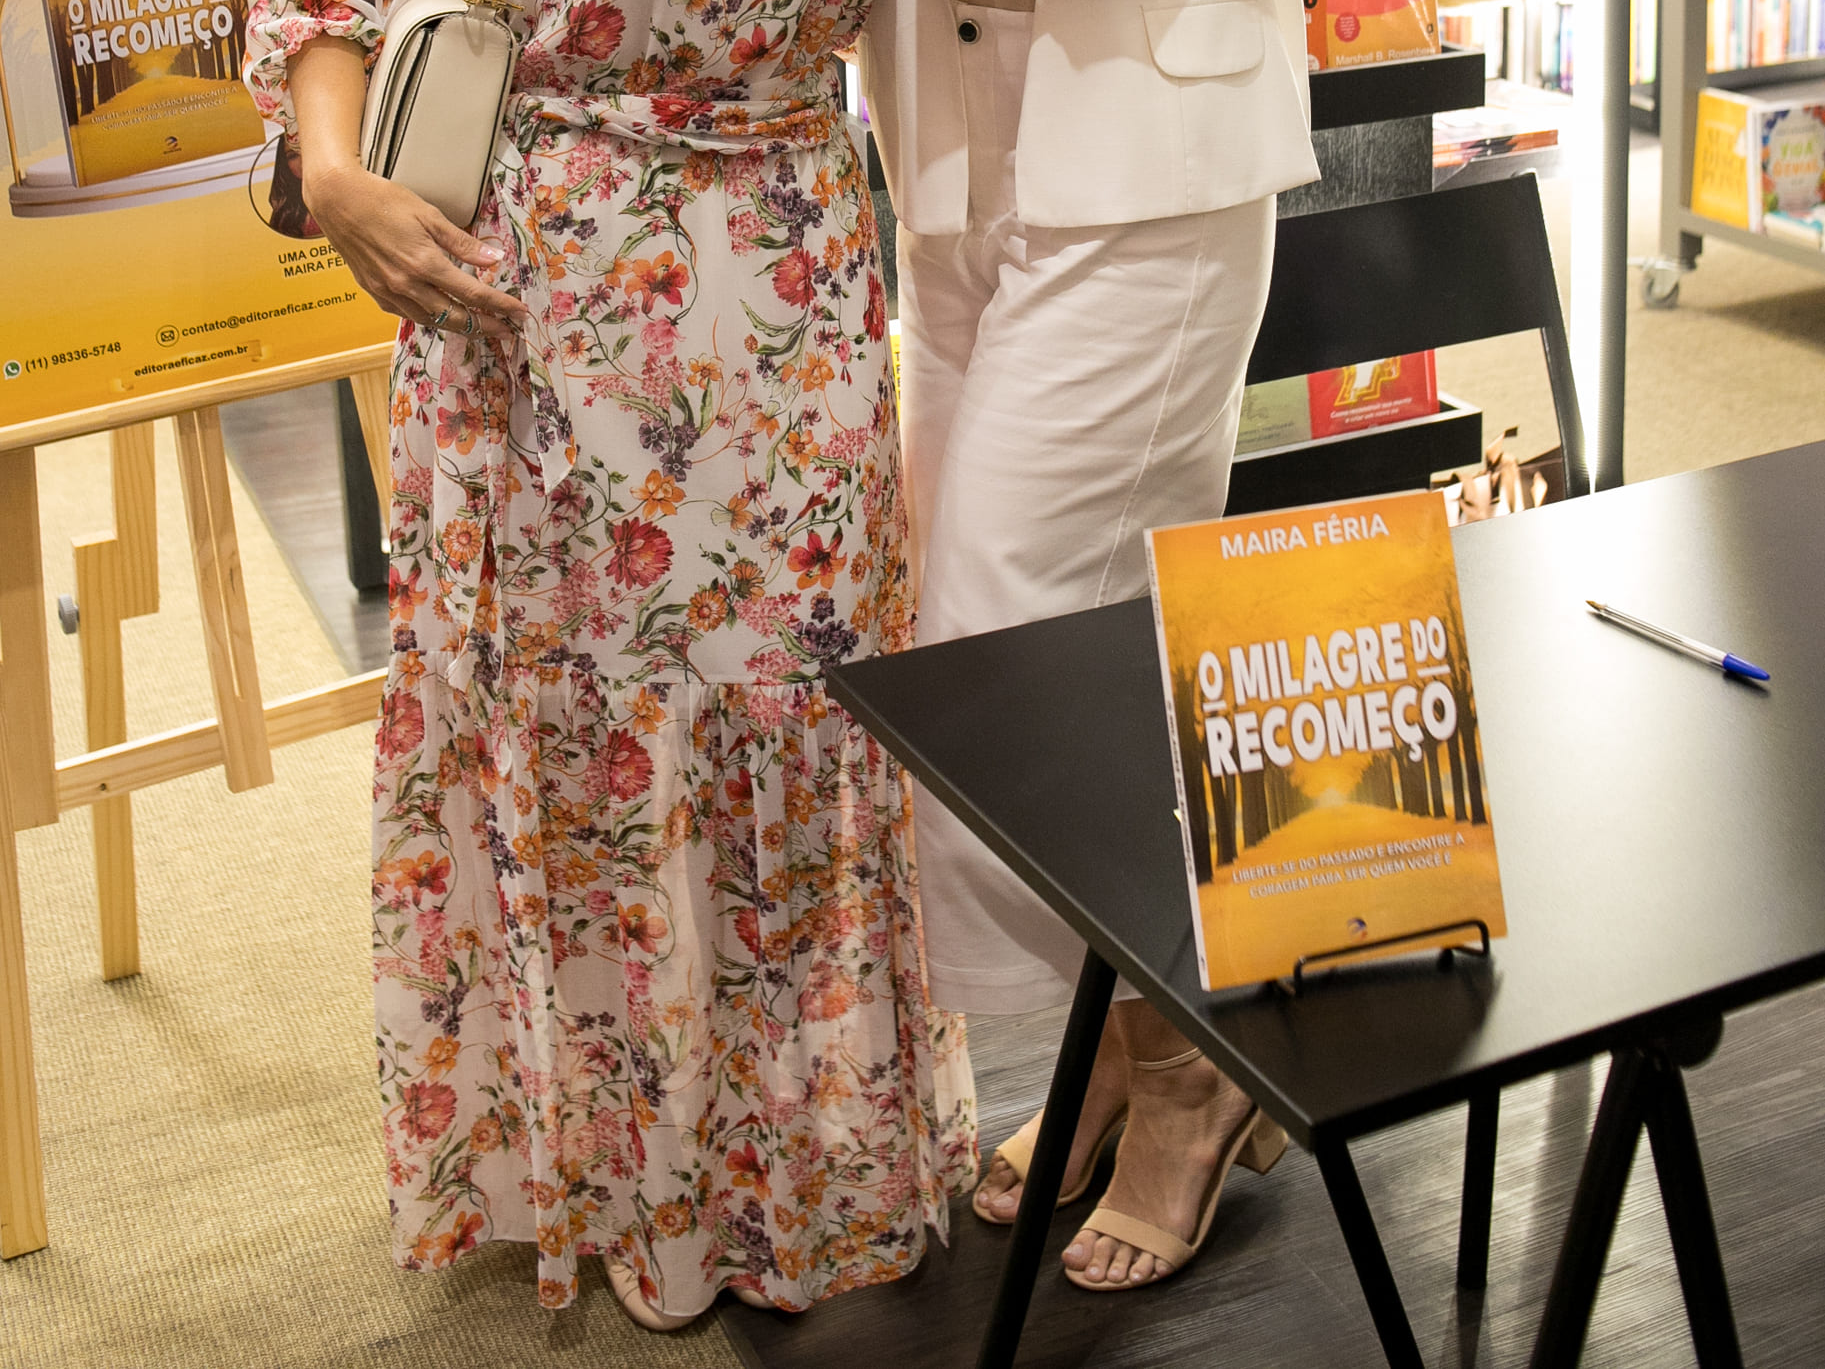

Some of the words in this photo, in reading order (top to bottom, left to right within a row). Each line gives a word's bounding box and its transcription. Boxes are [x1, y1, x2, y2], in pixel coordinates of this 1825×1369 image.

[72, 5, 234, 67] RECOMEÇO
[278, 250, 307, 264] UMA
[283, 260, 325, 278] MAIRA
[181, 291, 357, 337] contato@editoraeficaz.com.br
[25, 357, 49, 373] (11)
[51, 341, 122, 366] 98336-5748
[134, 344, 249, 377] editoraeficaz.com.br
[1220, 525, 1308, 560] MAIRA
[1312, 513, 1390, 546] FÉRIA
[1198, 651, 1223, 701] O
[1229, 622, 1408, 706] MILAGRE
[1409, 615, 1447, 663] DO
[1204, 680, 1457, 778] RECOMEÇO
[1232, 858, 1297, 884] LIBERTE-SE
[1298, 857, 1317, 872] DO
[1319, 846, 1375, 869] PASSADO
[1376, 844, 1385, 856] E
[1386, 833, 1453, 855] ENCONTRE
[1455, 831, 1465, 846] A
[1249, 877, 1309, 899] CORAGEM
[1312, 871, 1342, 888] PARA
[1344, 868, 1367, 882] SER
[1370, 861, 1406, 879] QUEM
